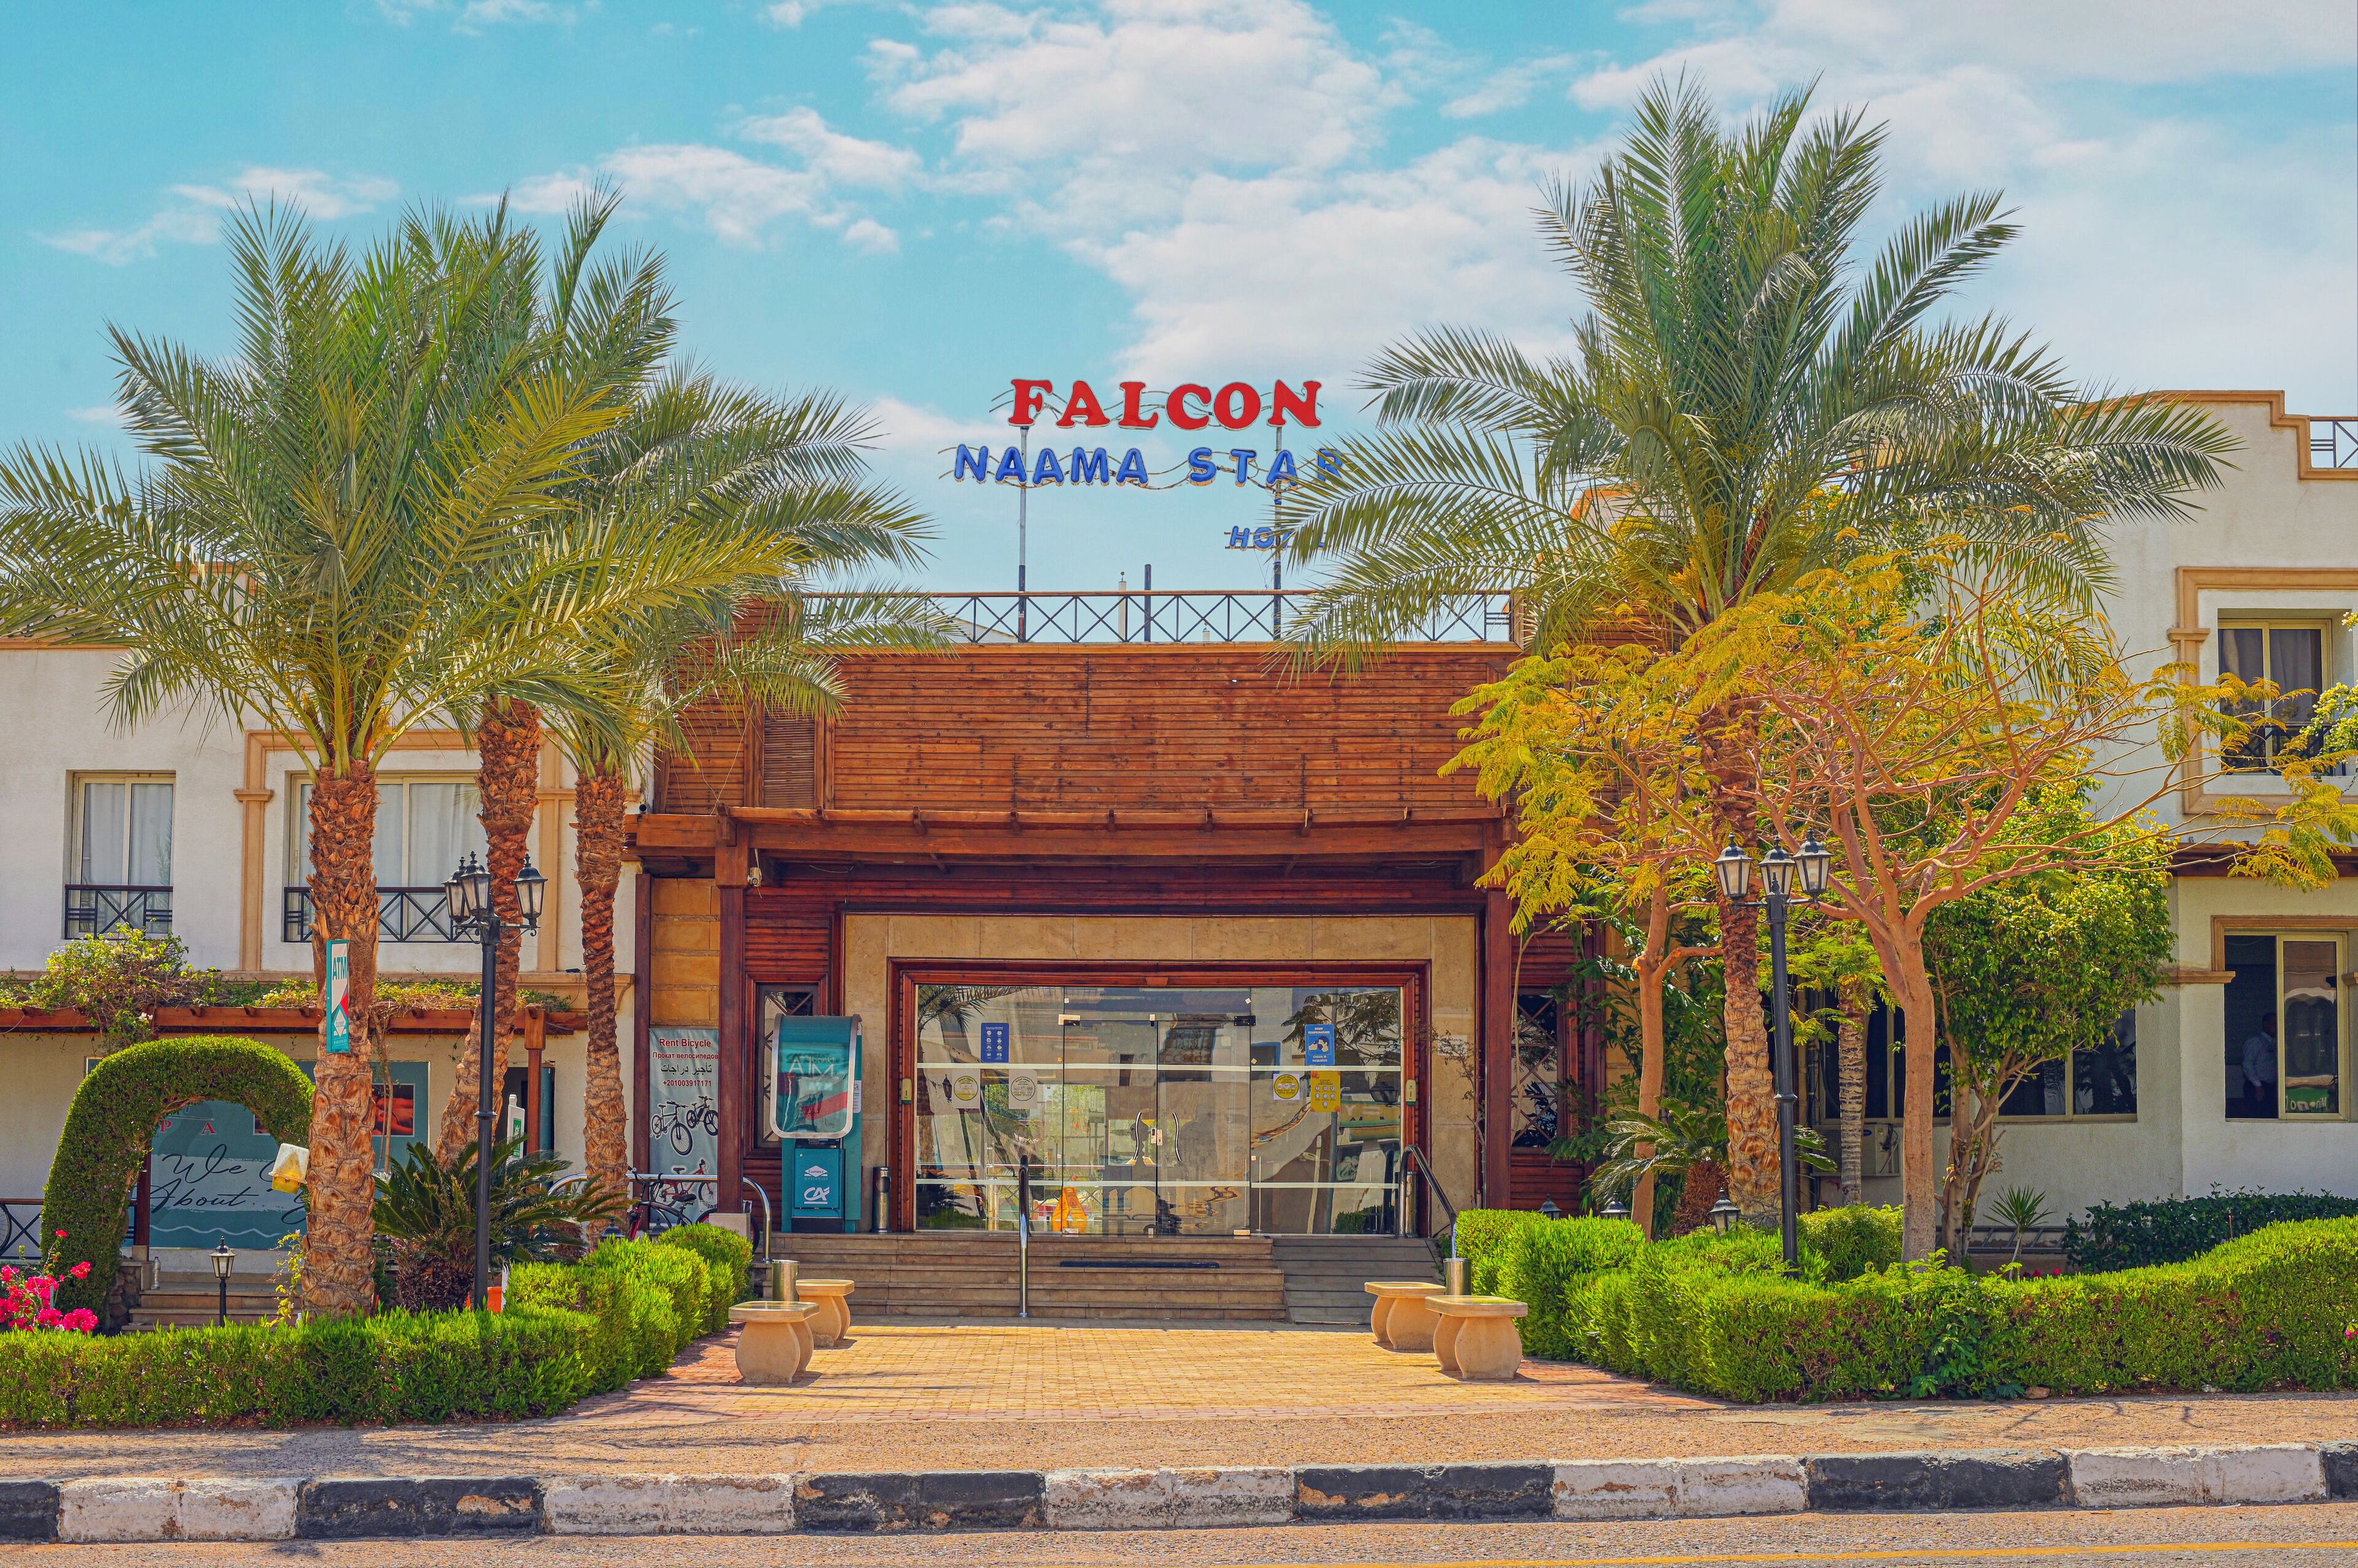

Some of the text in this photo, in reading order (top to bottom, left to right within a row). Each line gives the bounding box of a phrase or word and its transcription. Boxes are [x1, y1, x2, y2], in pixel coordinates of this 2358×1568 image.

[1008, 379, 1323, 430] FALCON
[954, 443, 1345, 489] NAAMA STAR
[332, 957, 347, 980] ATM
[659, 1038, 711, 1049] Rent Bicycle
[660, 1062, 712, 1076] تأجير دراجات
[788, 1055, 835, 1077] ATM
[160, 1119, 216, 1135] PA
[161, 1144, 247, 1184] We
[150, 1178, 259, 1213] About
